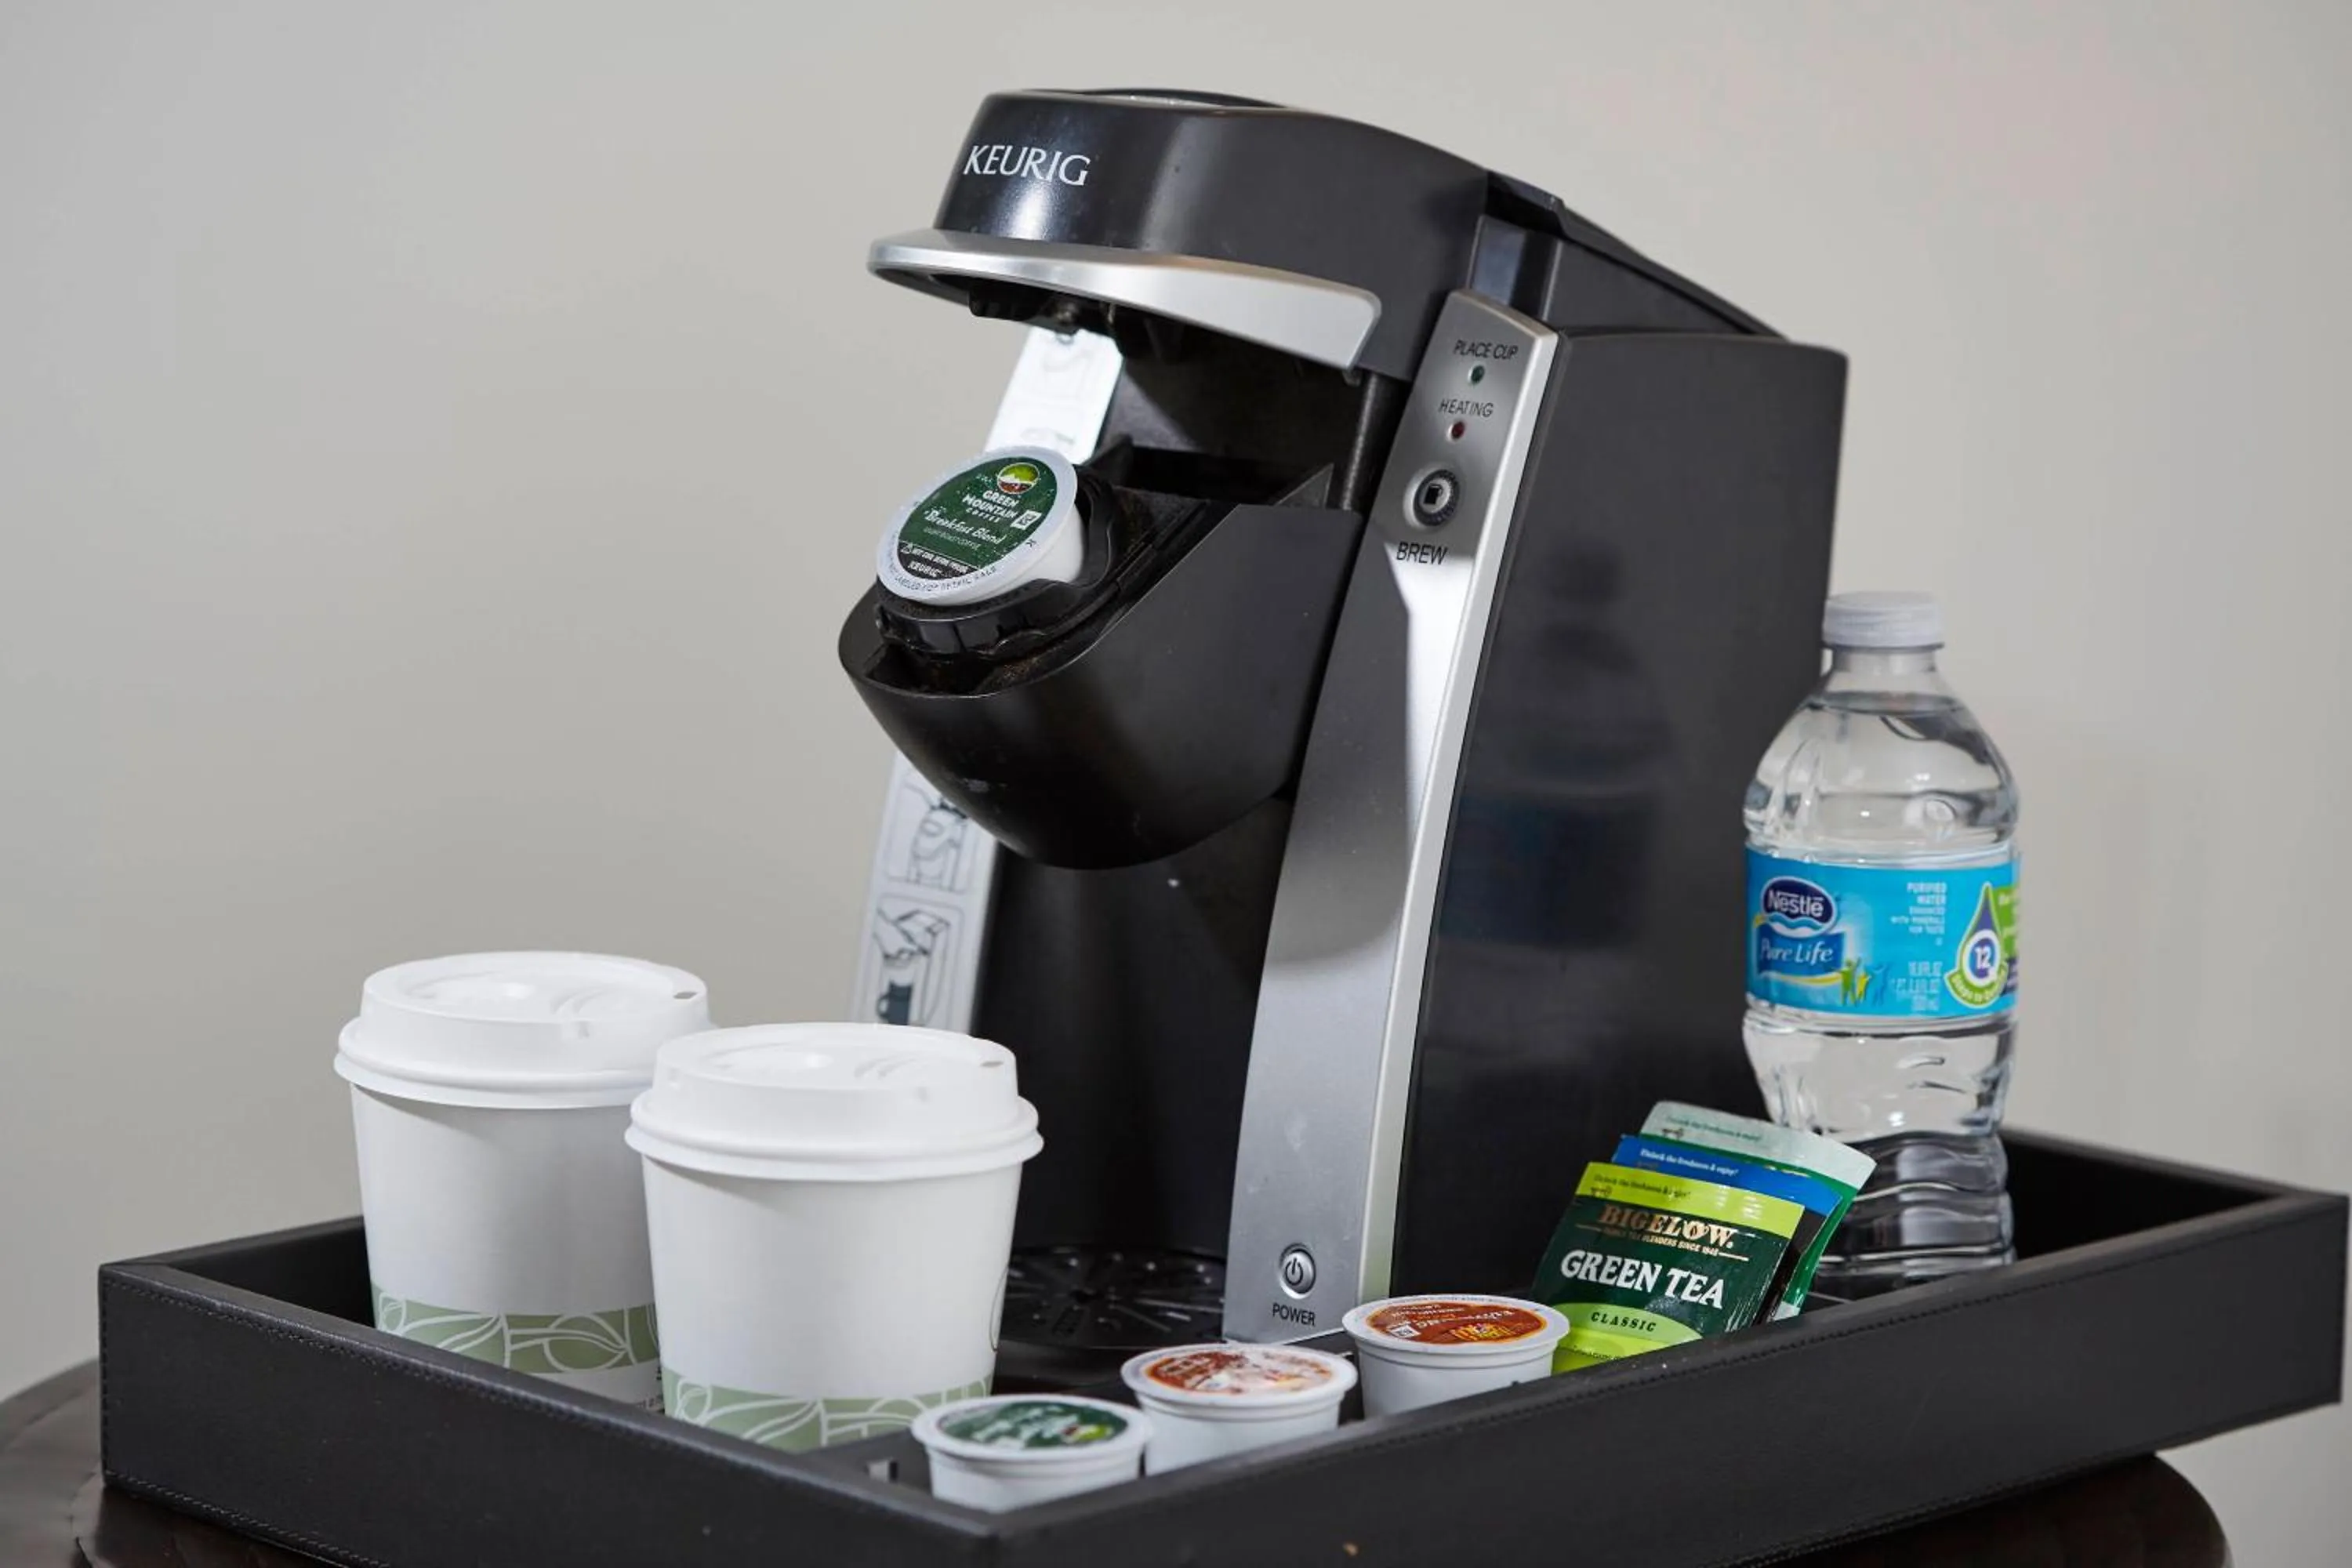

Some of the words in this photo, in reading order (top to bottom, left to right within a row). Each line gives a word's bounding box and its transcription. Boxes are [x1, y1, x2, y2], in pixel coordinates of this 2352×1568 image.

[963, 144, 1091, 186] KEURIG
[1453, 339, 1493, 358] PLACE
[1494, 343, 1519, 360] CUP
[1438, 398, 1494, 418] HEATING
[962, 494, 1018, 518] MOUNTAIN
[982, 490, 1019, 507] GREEN
[924, 509, 974, 534] Breakfast
[972, 527, 1007, 545] Blend
[1396, 541, 1448, 564] BREW
[1768, 889, 1824, 917] Nestlé
[1761, 938, 1792, 961] Pure
[1795, 941, 1833, 966] Life
[1974, 946, 1992, 969] 12
[1598, 1204, 1738, 1247] BIGELOW
[1560, 1249, 1662, 1293] GREEN
[1664, 1268, 1725, 1309] TEA
[1272, 1302, 1316, 1326] POWER
[1591, 1312, 1657, 1332] CLASSIC
